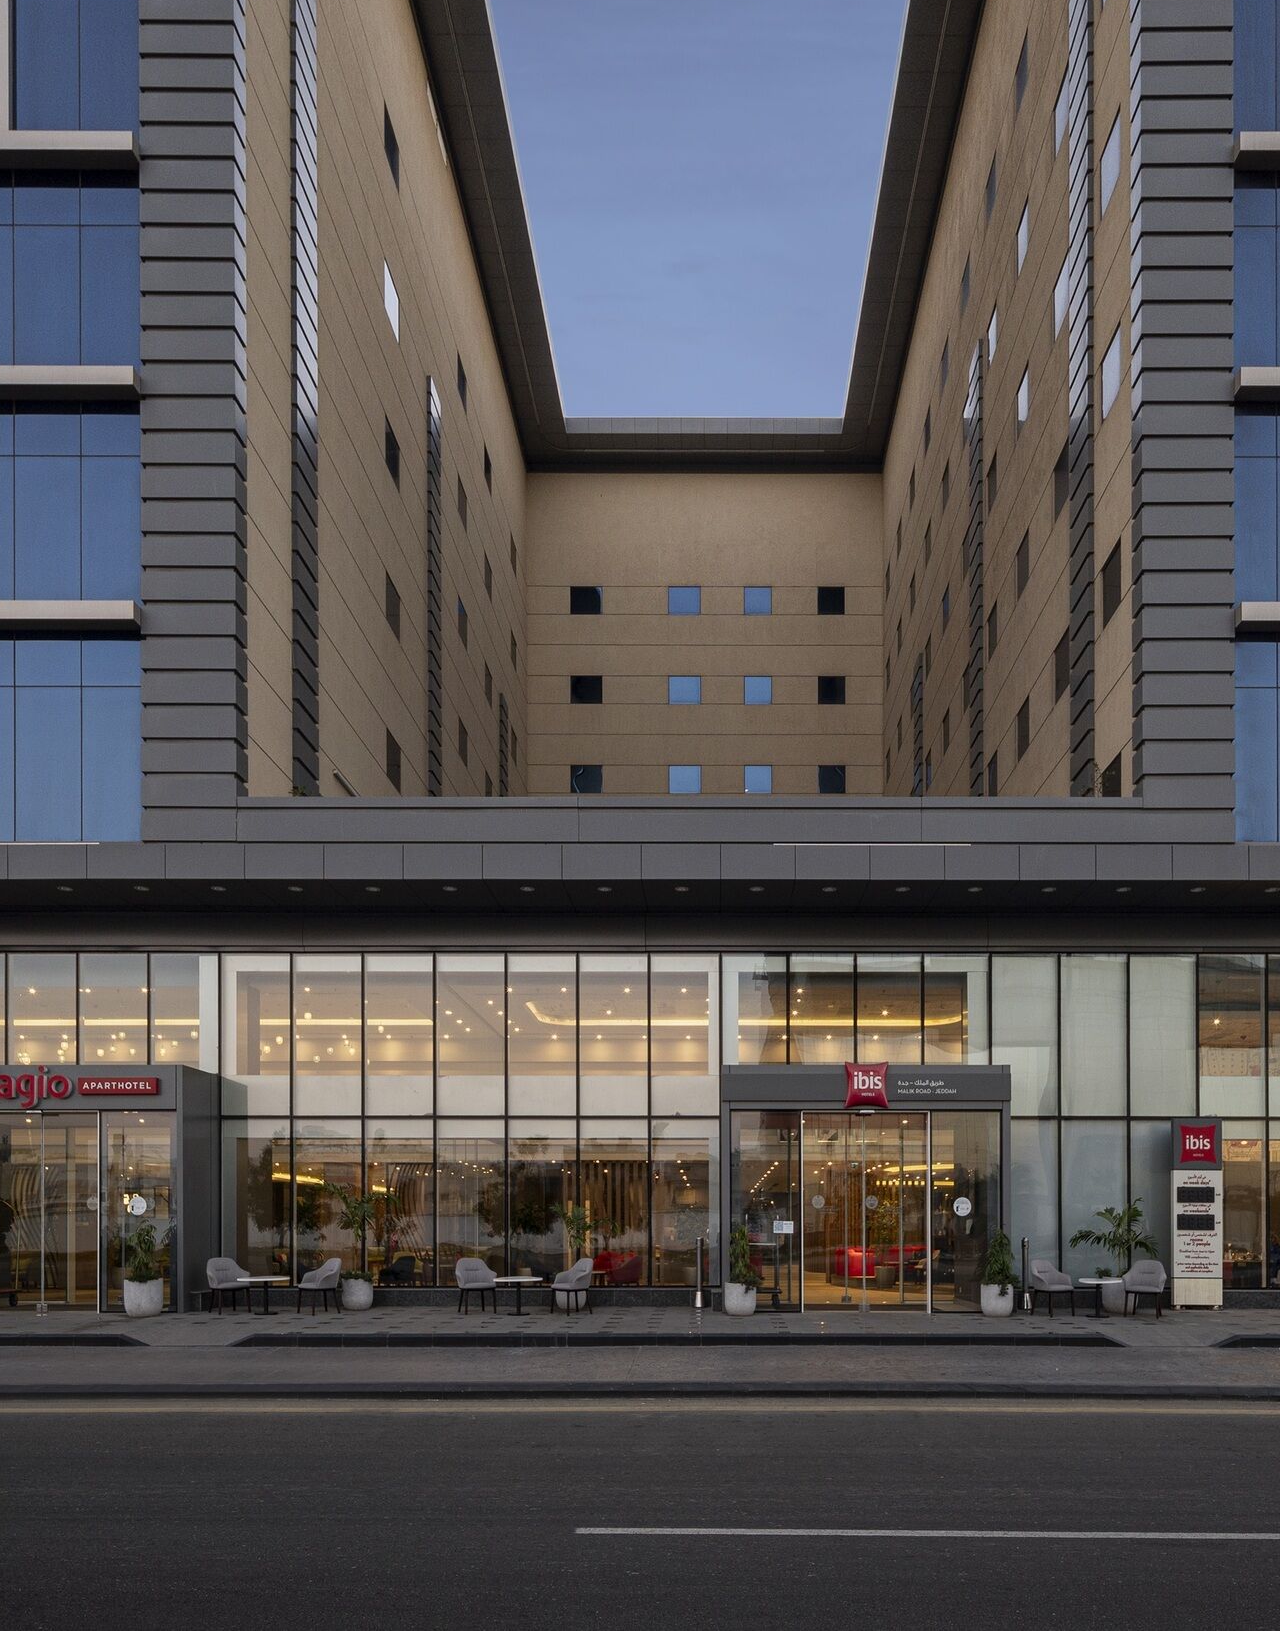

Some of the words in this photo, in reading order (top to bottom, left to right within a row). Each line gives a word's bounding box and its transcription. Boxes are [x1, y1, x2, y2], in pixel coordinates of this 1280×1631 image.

[82, 1081, 152, 1090] APARTHOTEL
[853, 1071, 883, 1090] ibis
[1185, 1135, 1211, 1150] ibis
